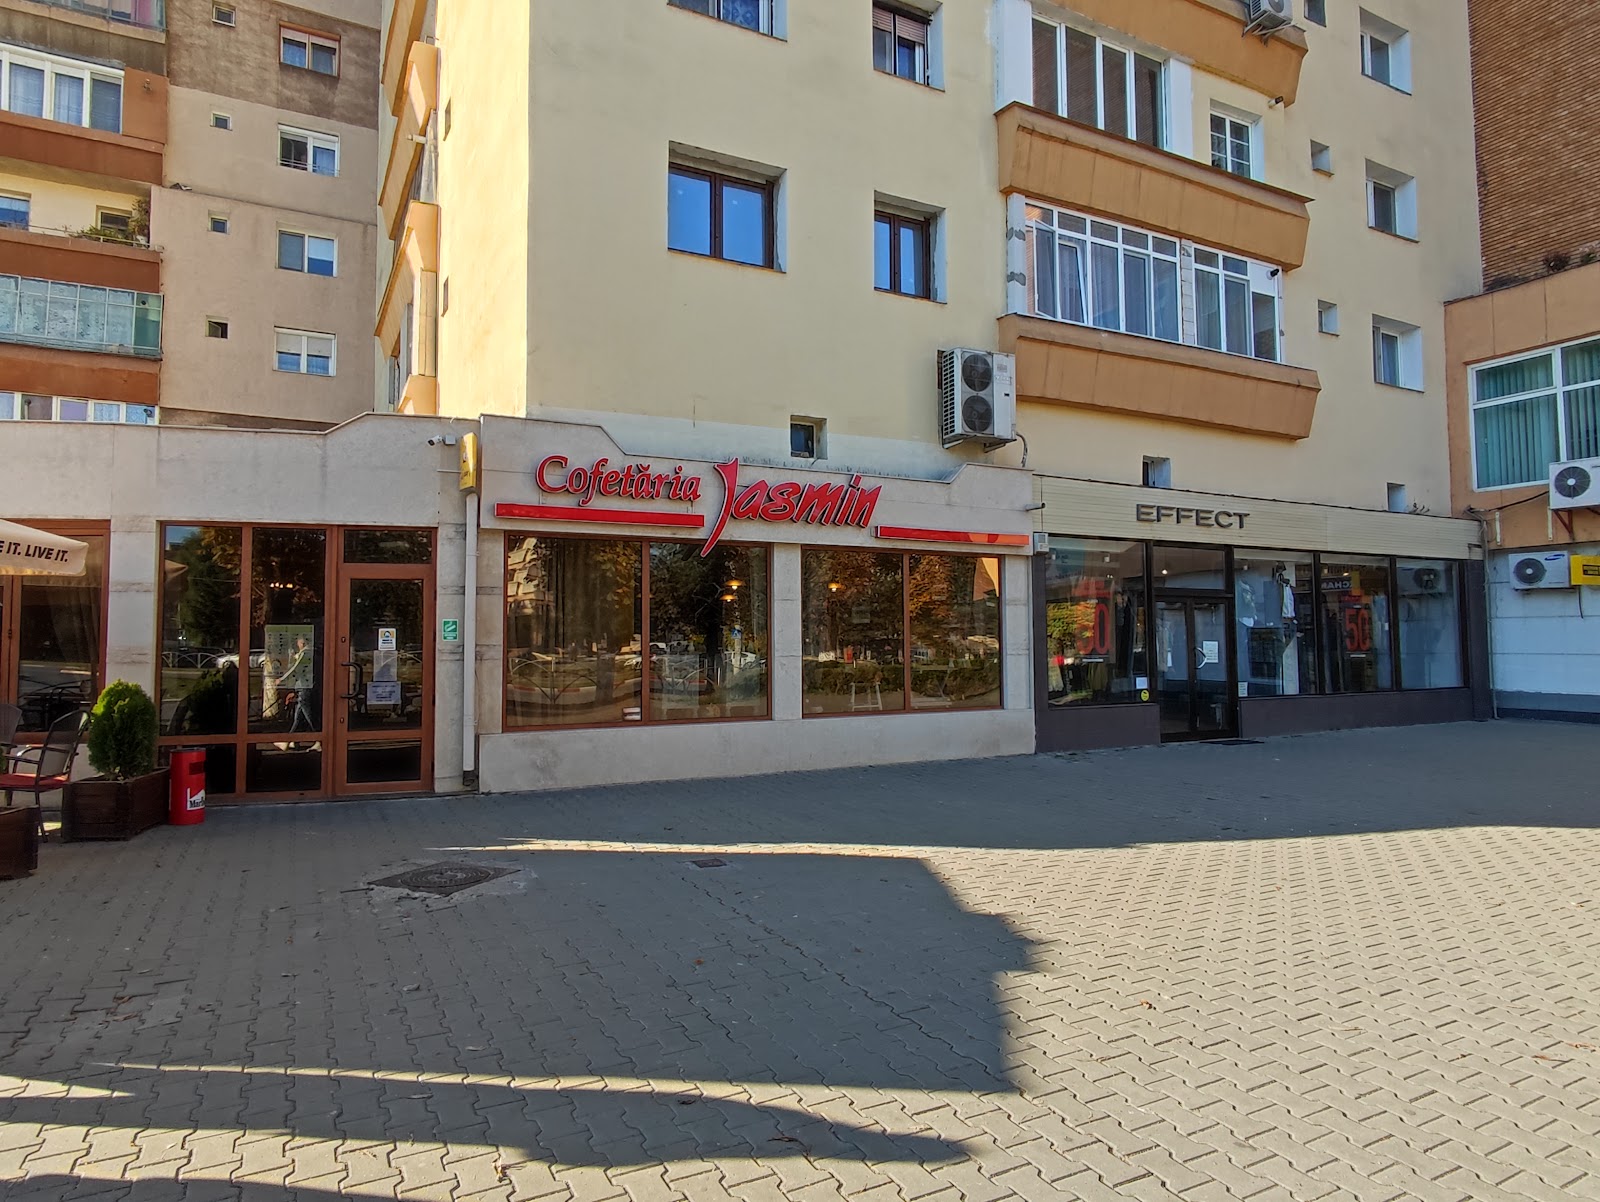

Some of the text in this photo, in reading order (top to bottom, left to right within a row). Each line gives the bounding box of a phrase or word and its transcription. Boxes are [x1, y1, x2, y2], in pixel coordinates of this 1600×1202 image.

[535, 454, 883, 557] Cofetăria Jasmin
[1136, 503, 1250, 529] EFFECT
[6, 541, 21, 556] IT.
[24, 544, 55, 560] LIVE
[54, 549, 69, 562] IT.
[1345, 608, 1371, 651] 50
